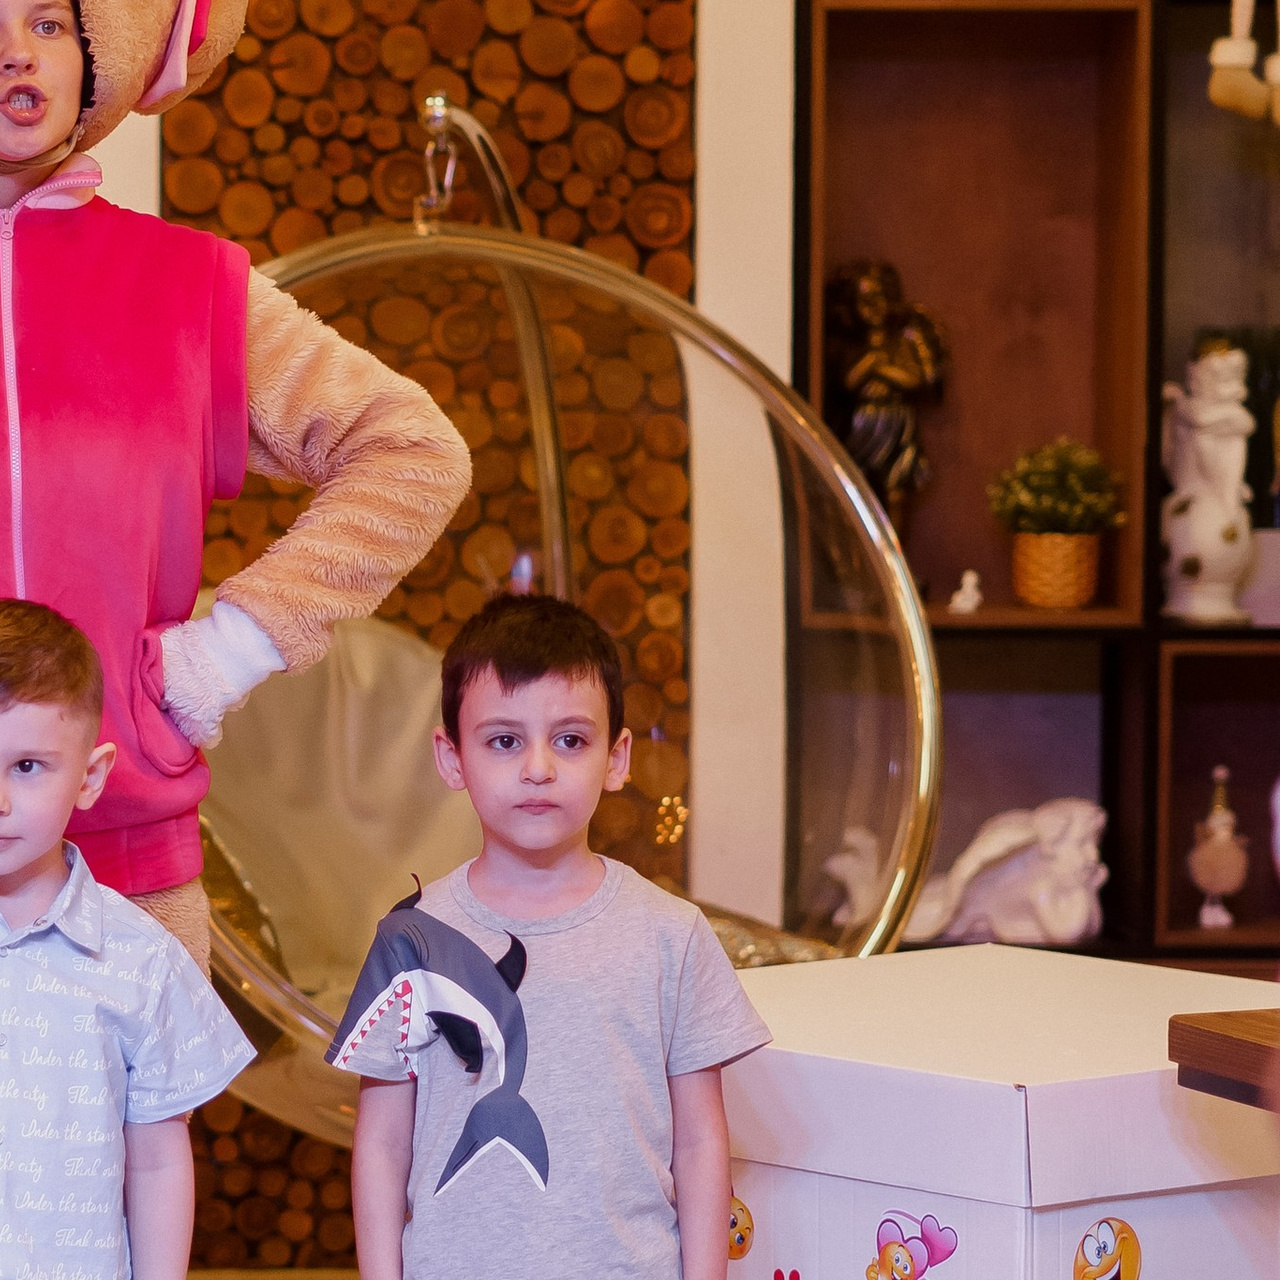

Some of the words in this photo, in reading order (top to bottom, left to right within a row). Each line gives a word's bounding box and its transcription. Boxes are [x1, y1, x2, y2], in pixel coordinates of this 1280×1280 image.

[25, 947, 51, 969] city
[72, 956, 114, 976] Think
[26, 973, 68, 996] Under
[72, 983, 93, 1000] the
[1, 1006, 21, 1026] the
[25, 1011, 50, 1038] city
[22, 1046, 63, 1067] Under
[68, 1048, 89, 1069] the
[0, 1078, 20, 1099] the
[23, 1084, 49, 1111] city
[67, 1084, 108, 1106] Think
[20, 1119, 62, 1139] Under
[64, 1120, 83, 1141] the
[18, 1156, 46, 1183] city
[64, 1157, 102, 1177] Think
[14, 1190, 54, 1211] Under
[58, 1192, 78, 1212] the
[55, 1228, 93, 1248] Think
